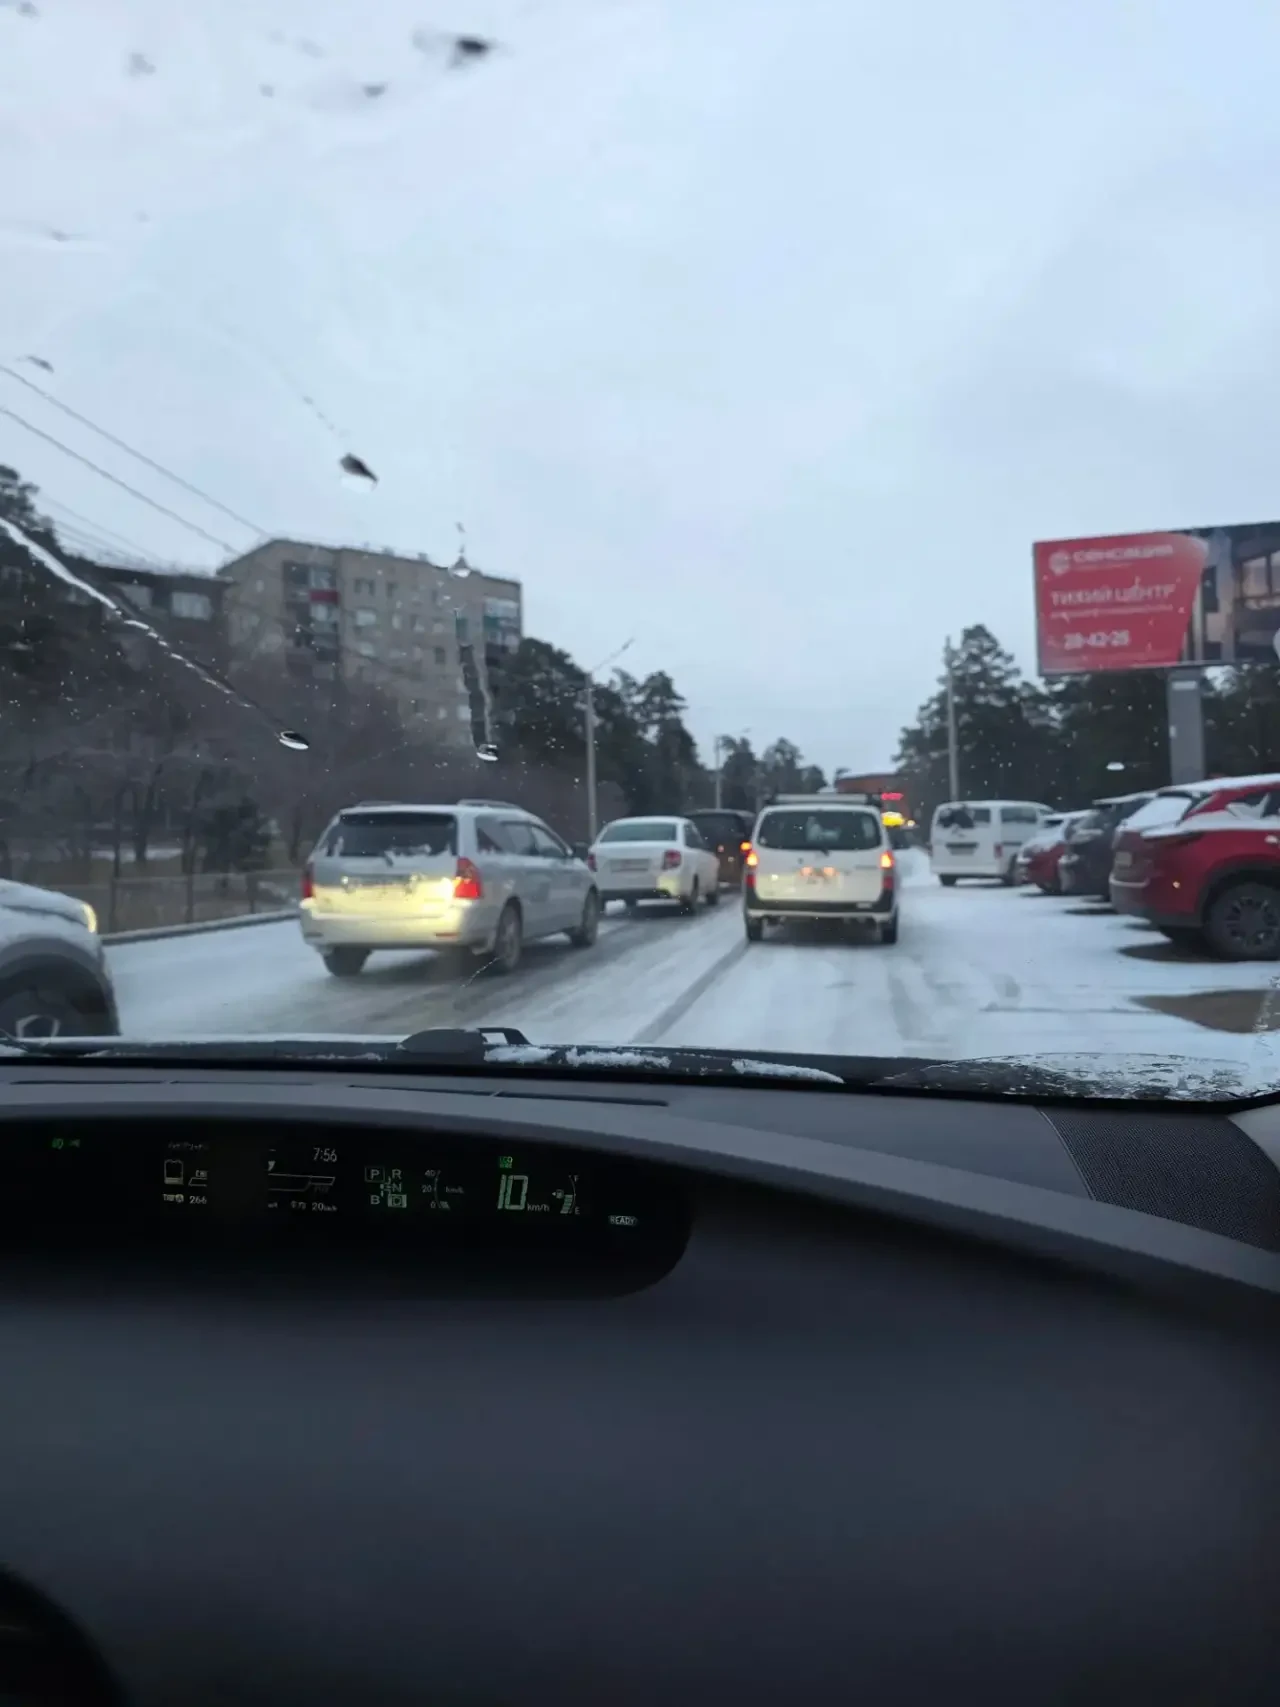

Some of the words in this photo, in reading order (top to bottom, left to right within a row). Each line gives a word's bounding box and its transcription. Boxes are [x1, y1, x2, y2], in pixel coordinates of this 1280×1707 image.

[313, 1146, 338, 1163] 7:56
[369, 1168, 381, 1180] P
[391, 1168, 403, 1181] R
[392, 1182, 403, 1193] N
[421, 1184, 433, 1194] 20
[496, 1173, 529, 1211] 10
[526, 1203, 551, 1213] km/h
[370, 1194, 381, 1206] B
[609, 1215, 637, 1227] READY
